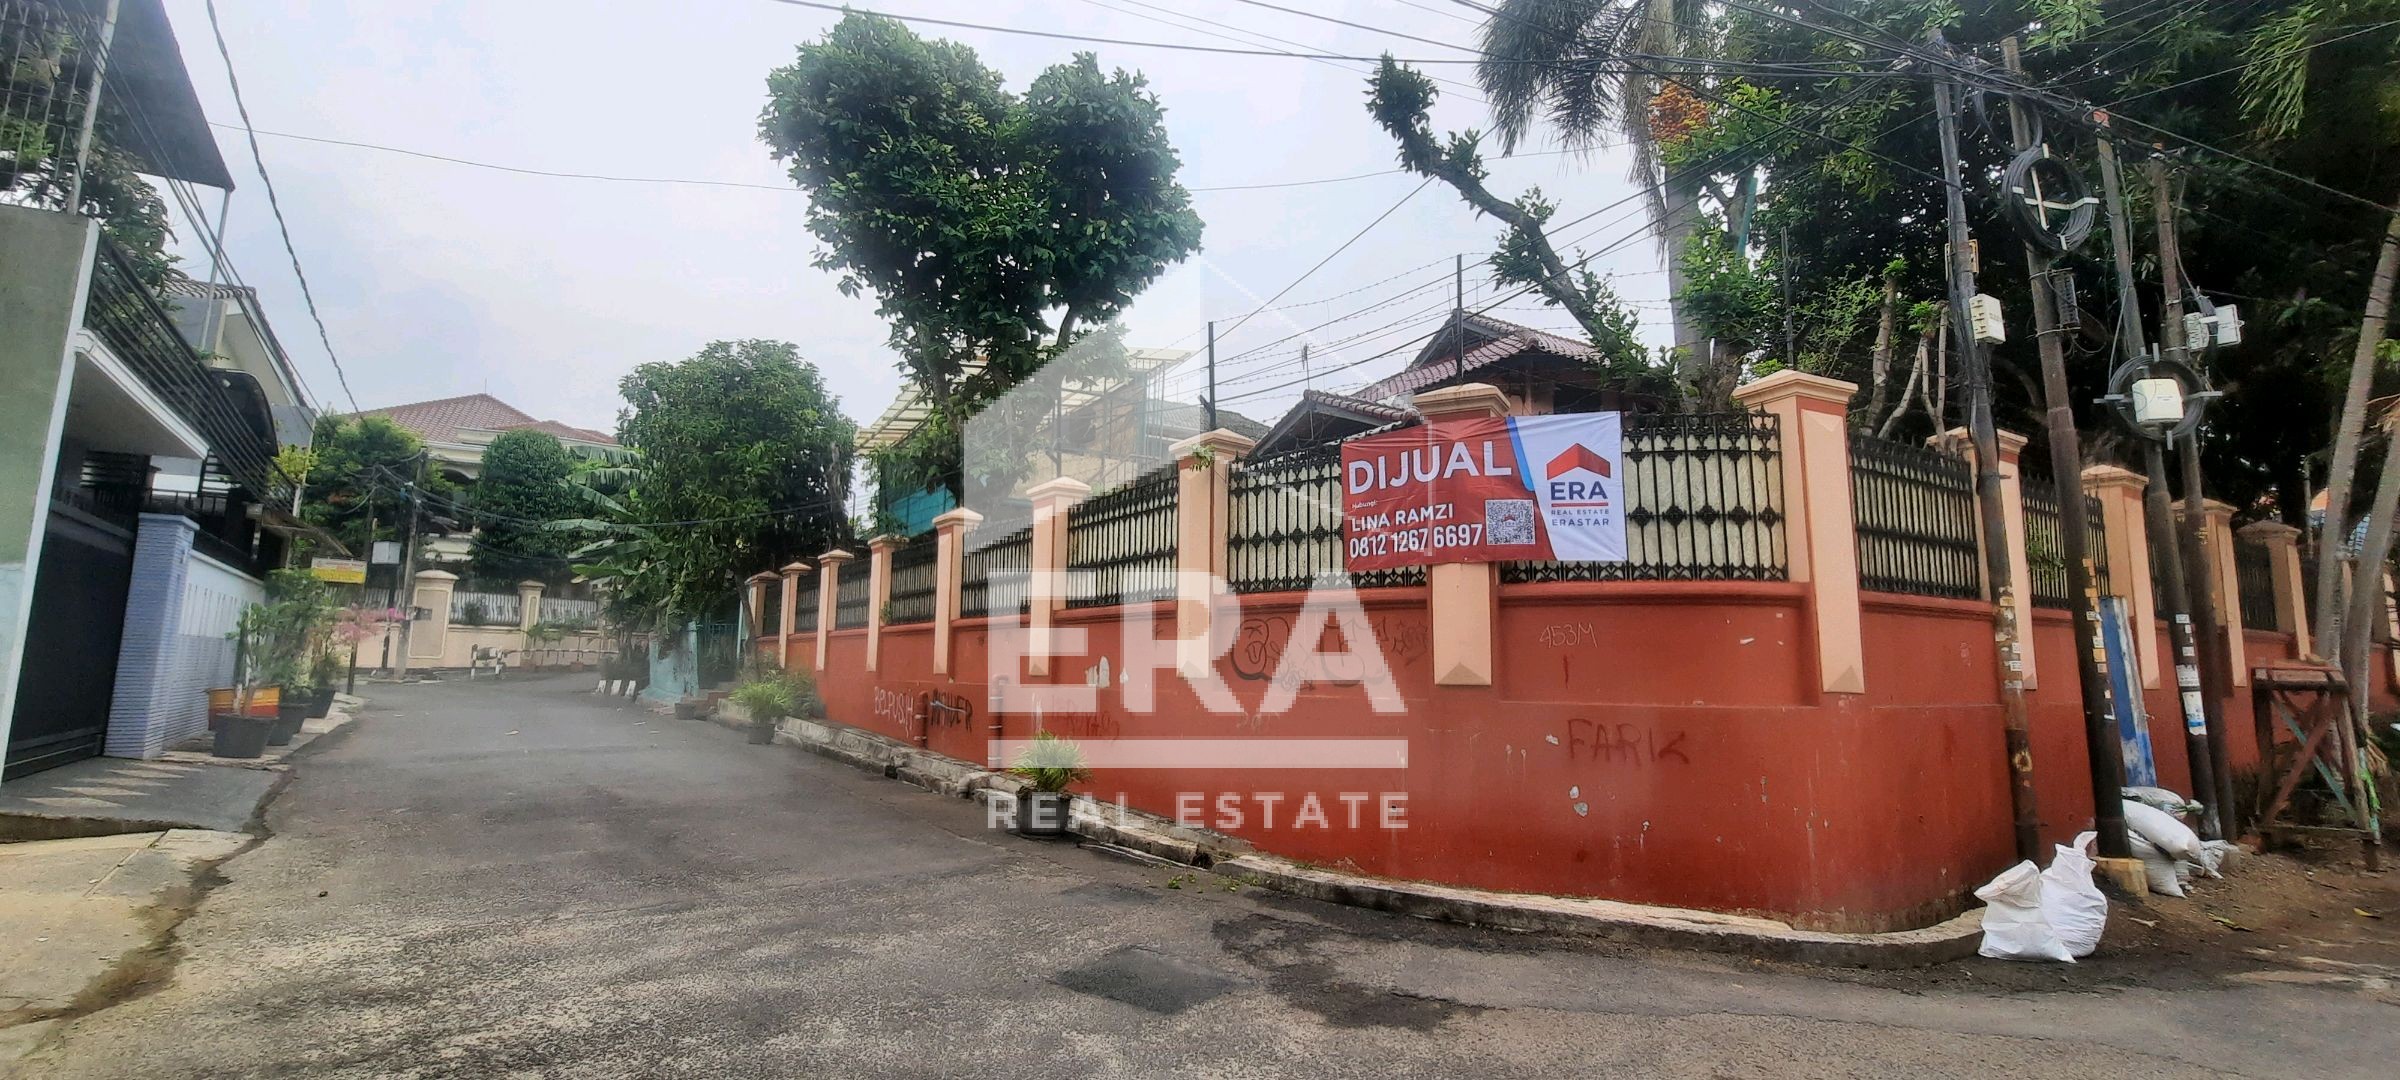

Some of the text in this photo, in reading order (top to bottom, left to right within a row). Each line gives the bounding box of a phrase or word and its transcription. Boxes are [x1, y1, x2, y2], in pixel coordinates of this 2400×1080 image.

[1348, 441, 1511, 494] DIJUAL
[1550, 481, 1608, 500] ERA
[1351, 503, 1453, 532] LINA RAMZI
[1551, 508, 1573, 516] REAL
[1552, 518, 1609, 527] ERASTAR
[1349, 523, 1483, 558] 0812 1267 6697
